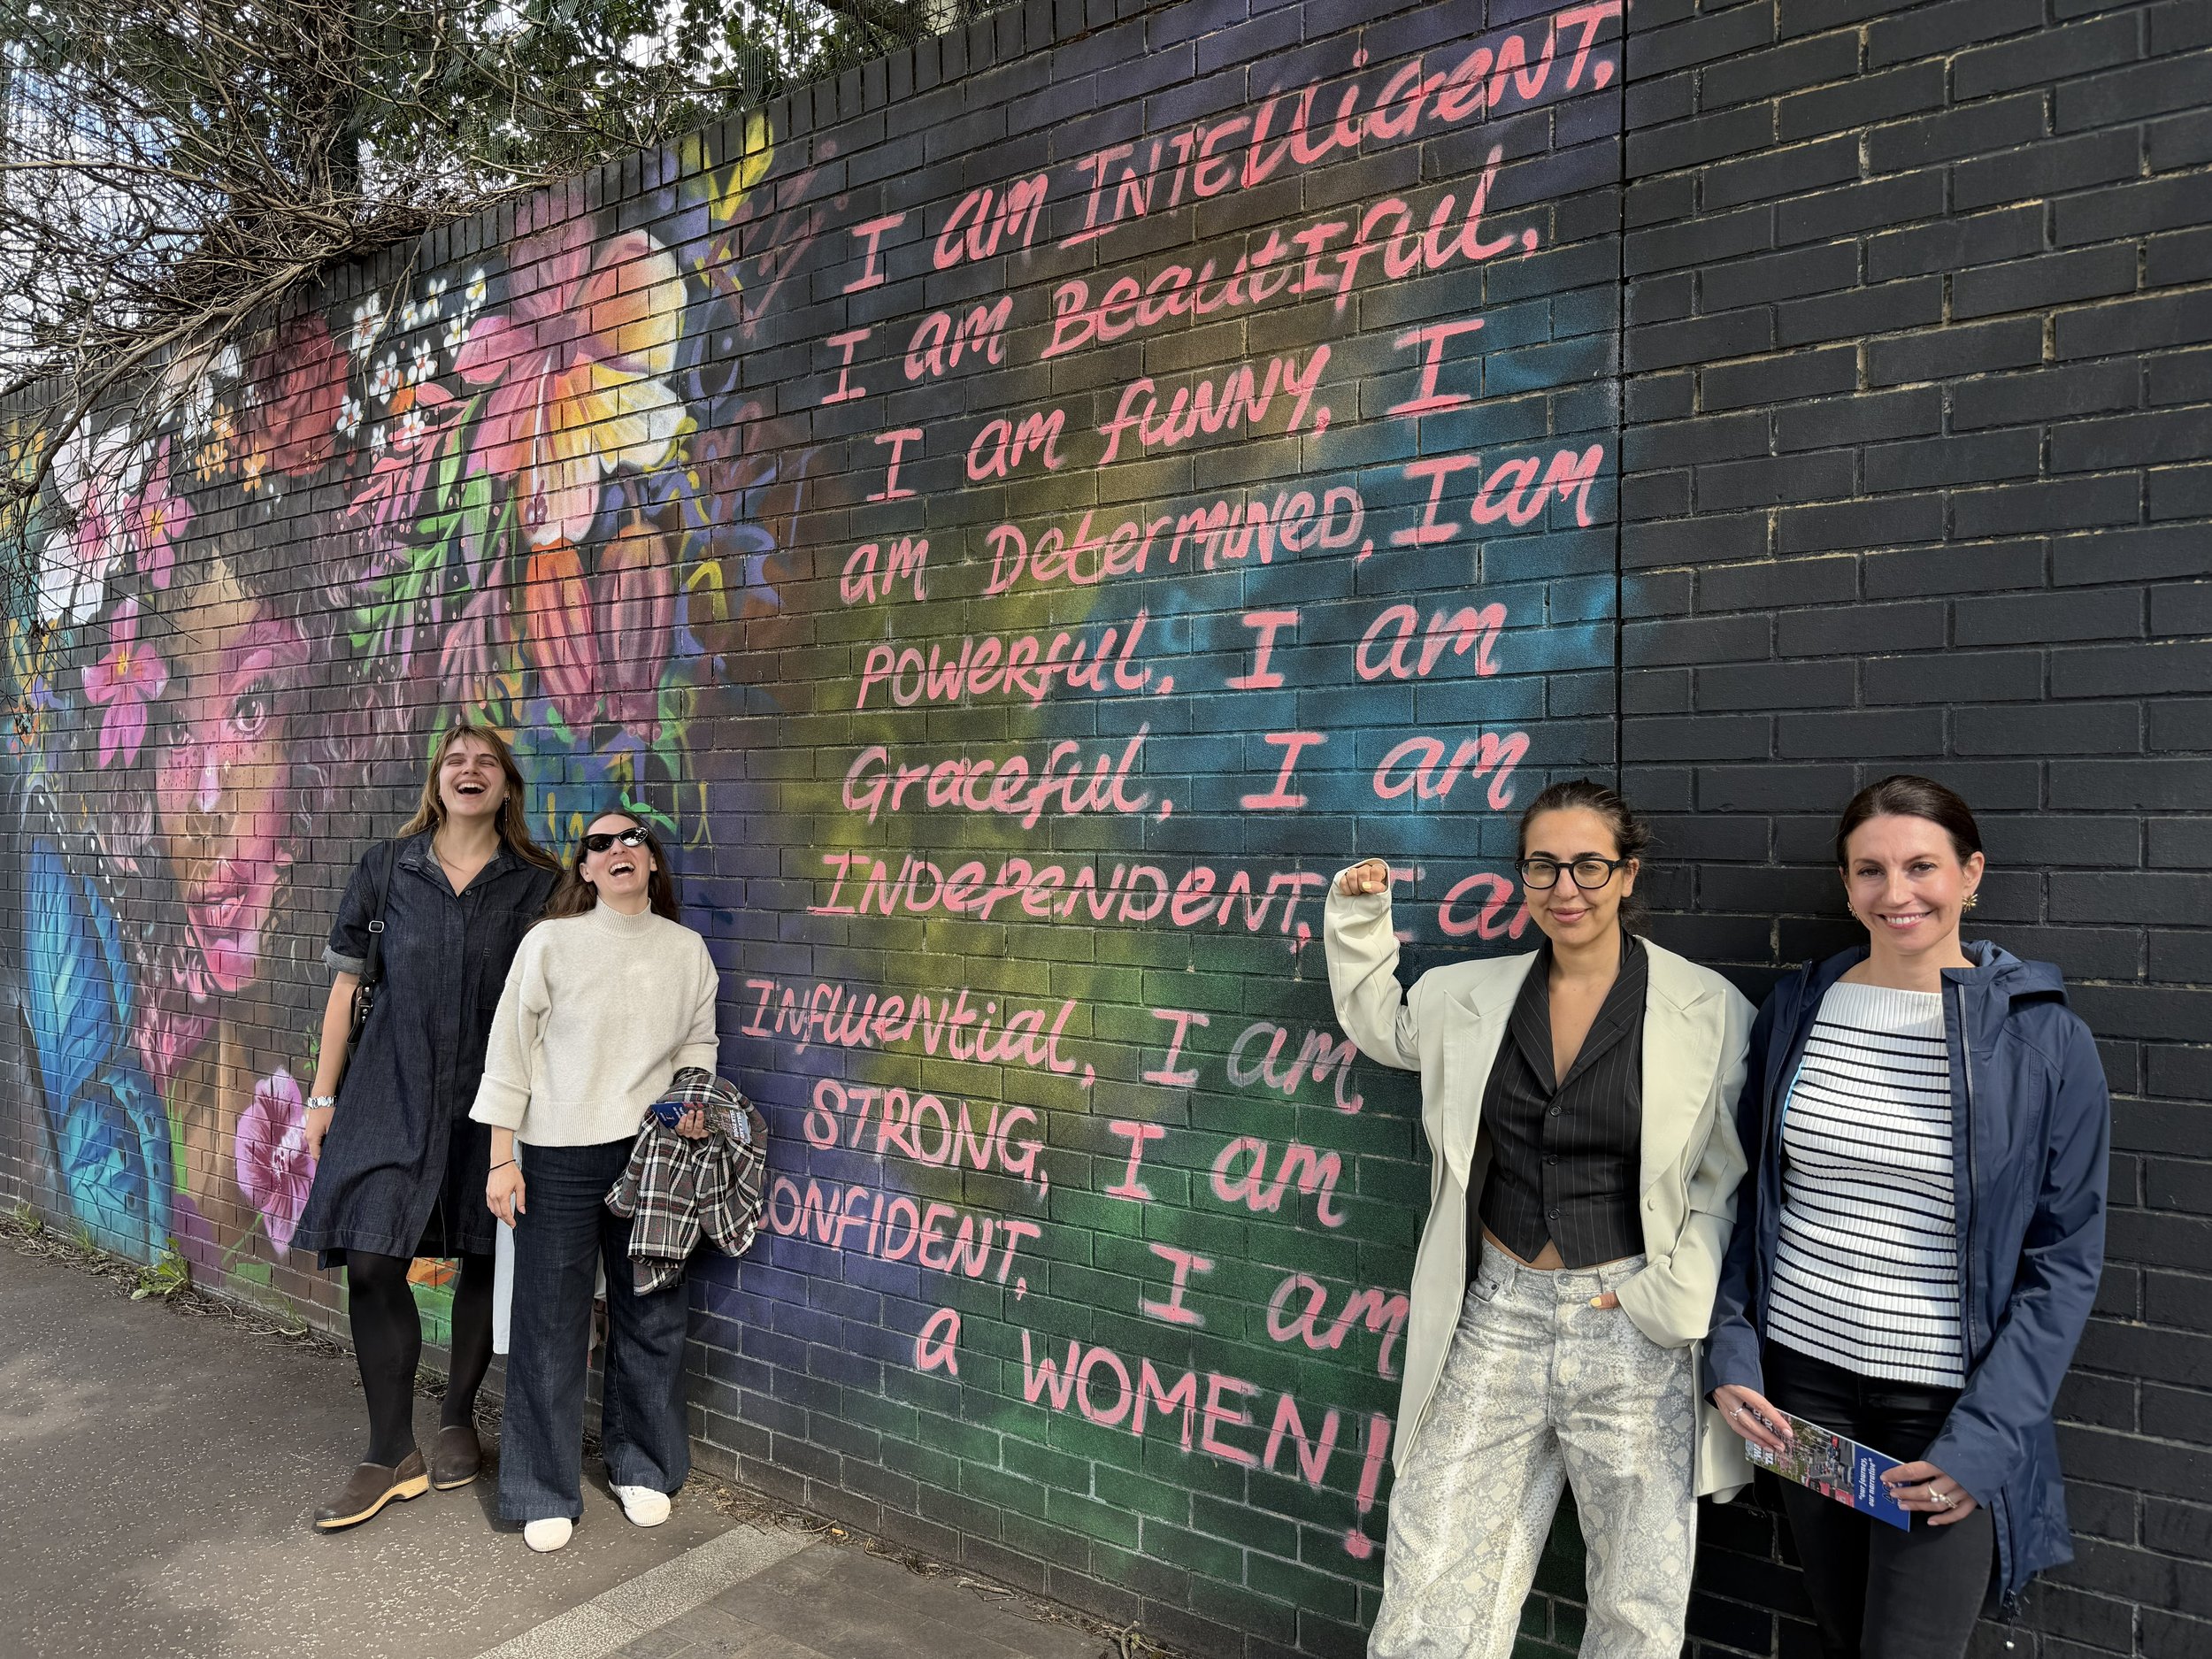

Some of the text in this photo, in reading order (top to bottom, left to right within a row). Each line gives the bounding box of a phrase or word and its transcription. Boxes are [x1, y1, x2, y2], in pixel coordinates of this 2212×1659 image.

[843, 212, 906, 294] I
[822, 328, 872, 406] I
[904, 296, 1013, 380] am
[866, 428, 923, 502] I
[967, 408, 1066, 480] am
[1394, 319, 1485, 418] I
[840, 538, 929, 605] am
[1390, 455, 1480, 546] I
[1471, 444, 1603, 527] am
[1225, 611, 1298, 689] I
[1356, 603, 1507, 680] am
[1240, 732, 1326, 810] I
[1372, 731, 1530, 811] am
[1144, 1009, 1210, 1087] I
[1227, 1021, 1363, 1113] am
[803, 1079, 1347, 1227] STRONG, I am
[757, 1176, 1410, 1379] ONFIDENT, I am
[917, 1308, 1391, 1558] a WOMEN!
